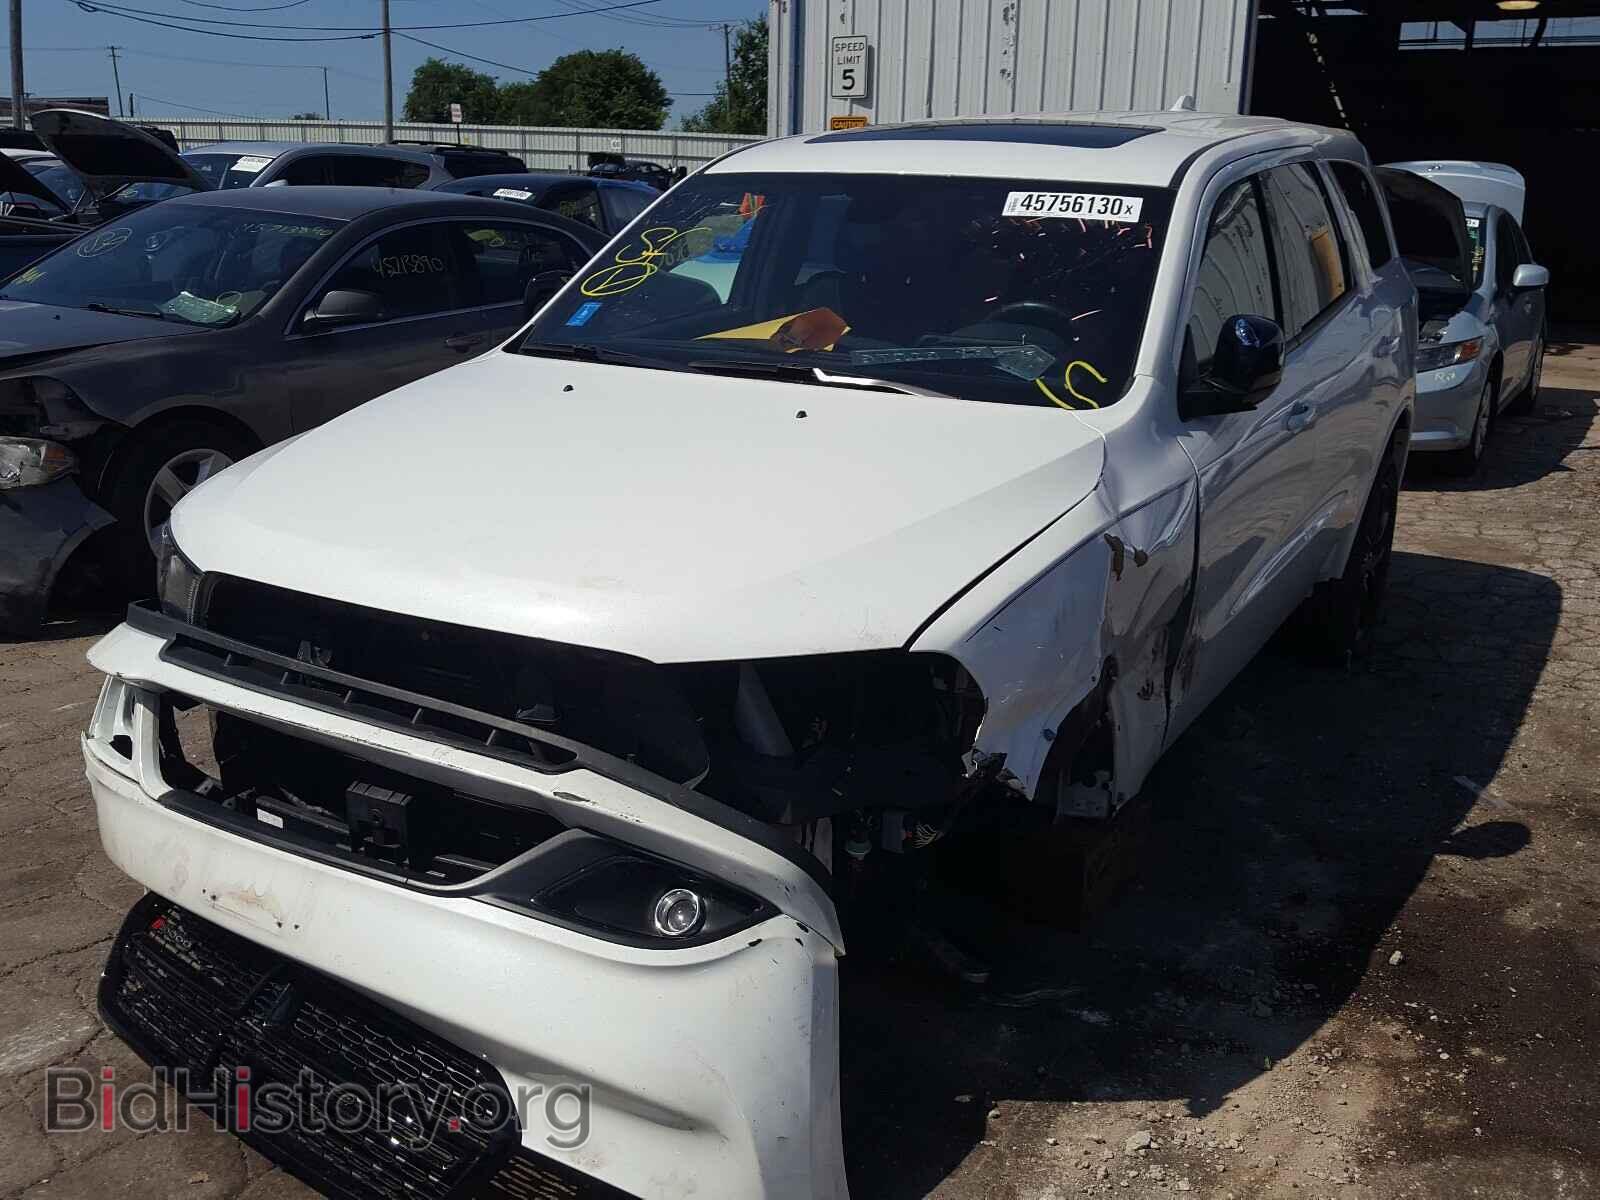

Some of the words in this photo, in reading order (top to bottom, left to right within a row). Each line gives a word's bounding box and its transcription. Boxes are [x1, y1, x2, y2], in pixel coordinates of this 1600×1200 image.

[834, 42, 865, 52] SPEED
[837, 55, 861, 65] LIMIT
[842, 68, 855, 90] 5
